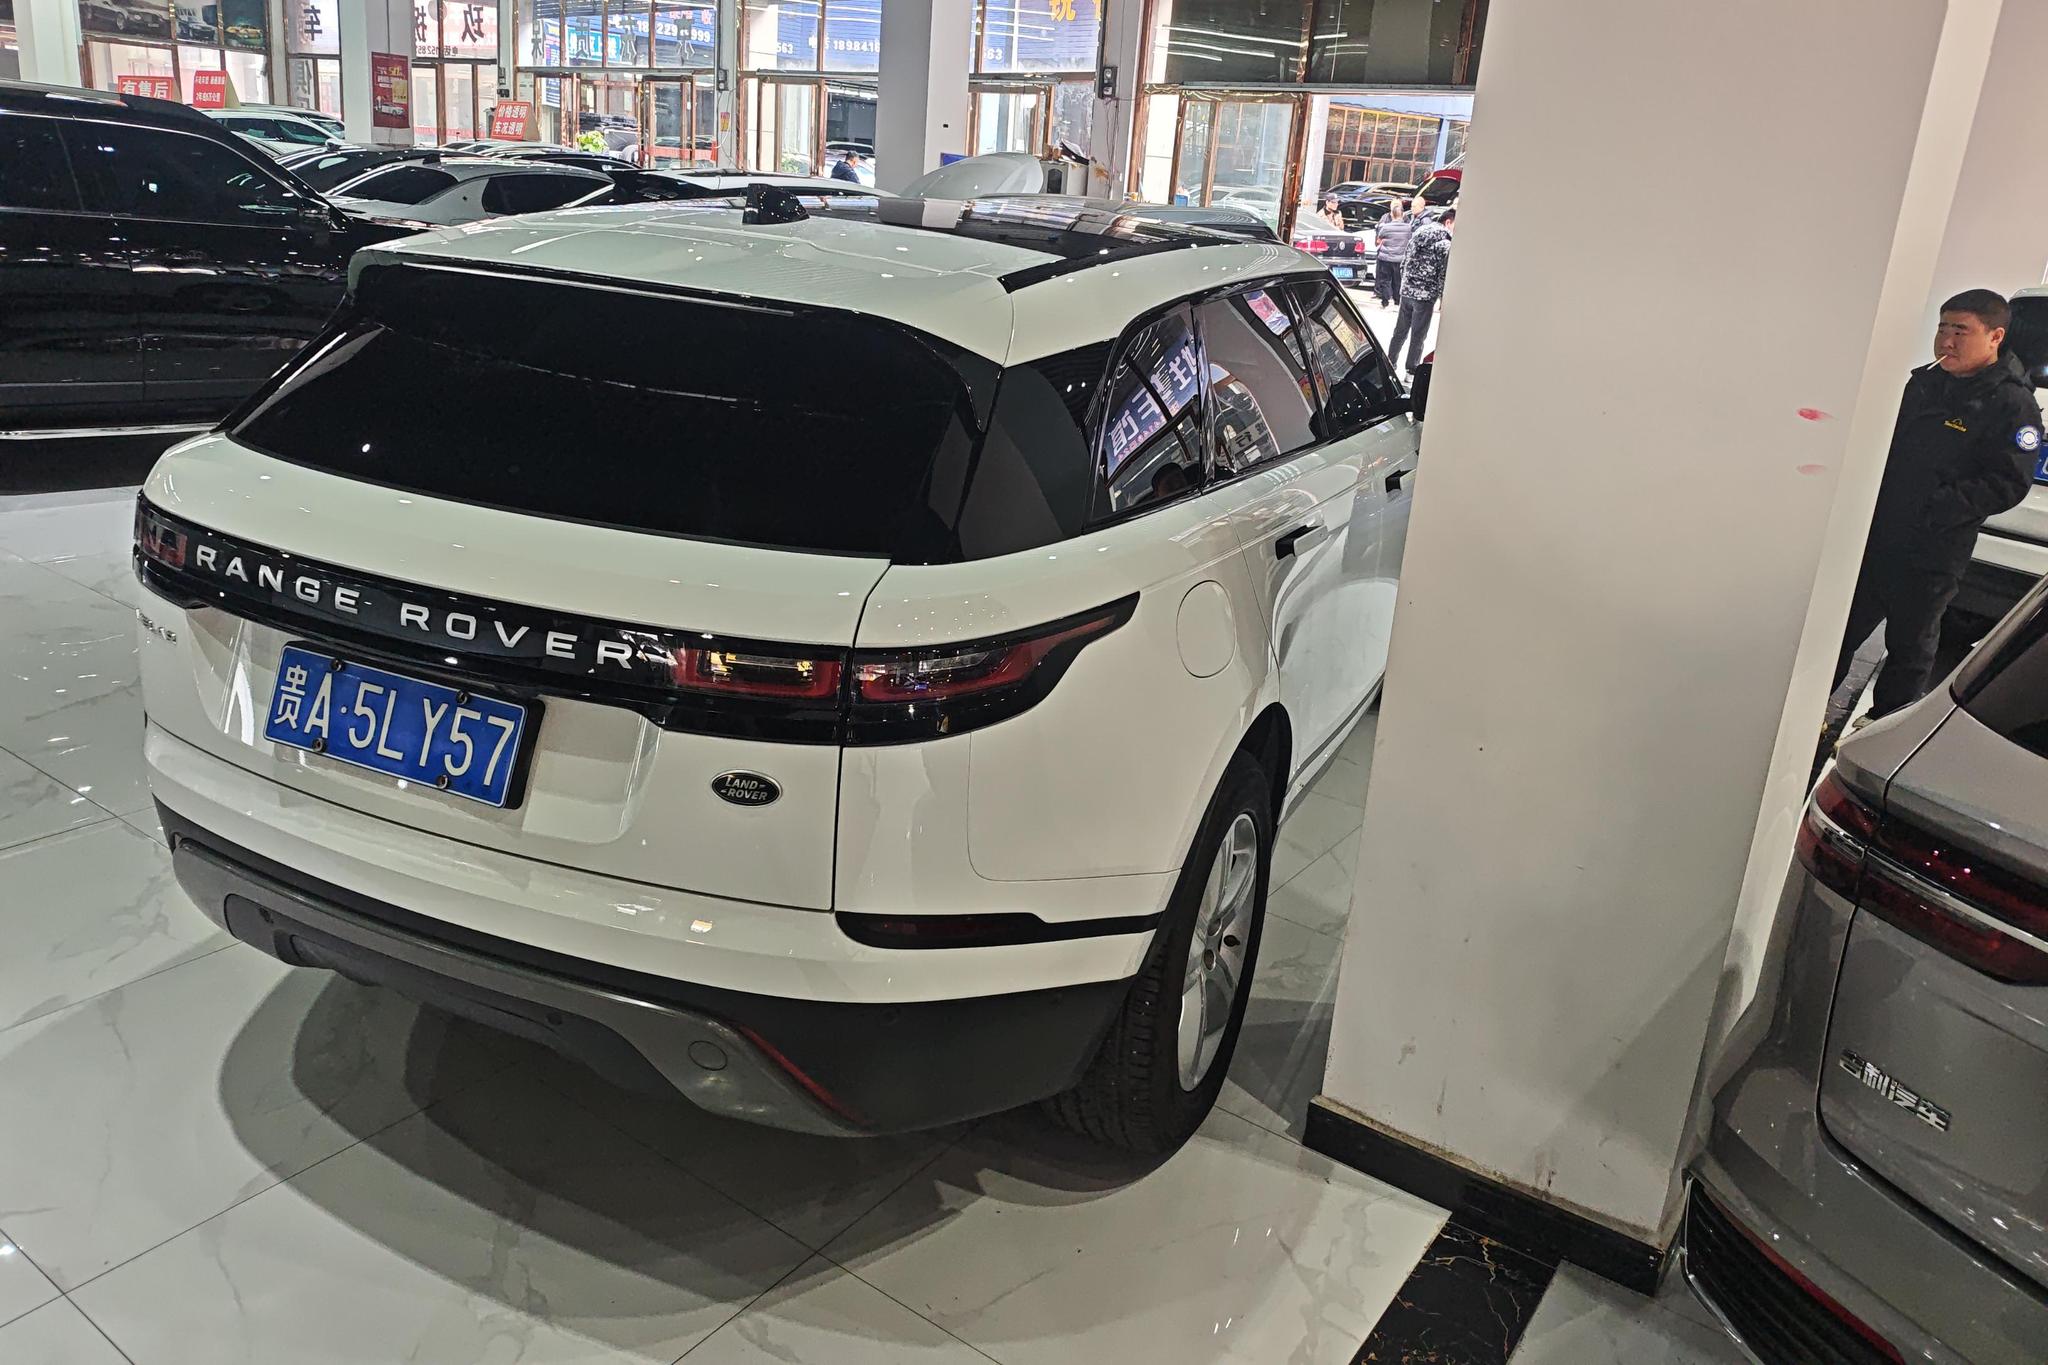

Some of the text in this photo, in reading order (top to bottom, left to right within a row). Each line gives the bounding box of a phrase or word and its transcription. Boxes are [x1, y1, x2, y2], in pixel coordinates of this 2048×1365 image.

[121, 79, 169, 99] 有售后
[195, 544, 636, 670] RANGE ROVER
[725, 776, 759, 790] LAND
[727, 788, 768, 801] ROVER
